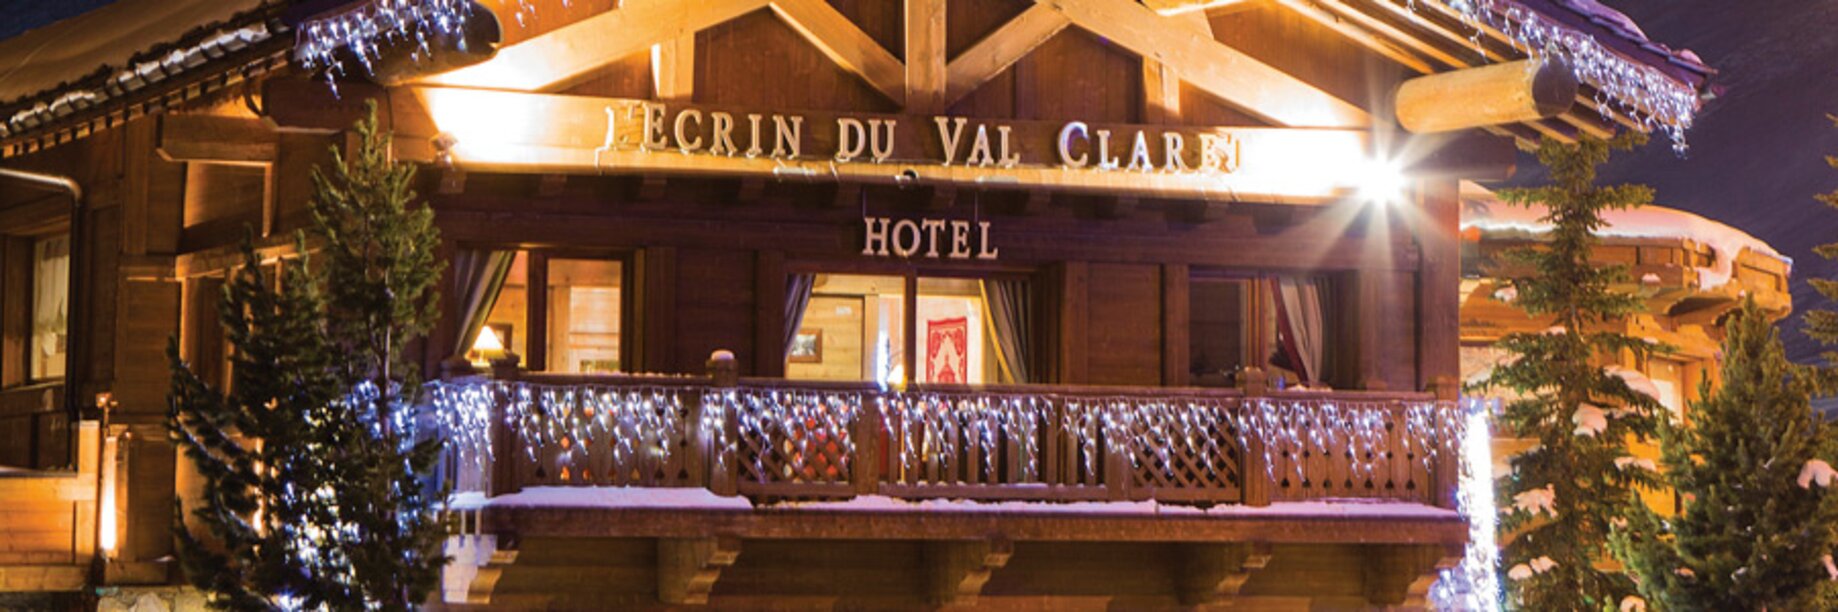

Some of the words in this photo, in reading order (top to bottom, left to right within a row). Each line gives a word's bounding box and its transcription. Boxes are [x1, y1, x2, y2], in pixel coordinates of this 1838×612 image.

[836, 117, 896, 162] DU
[934, 116, 1020, 167] VAL
[862, 217, 998, 260] HOTEL
